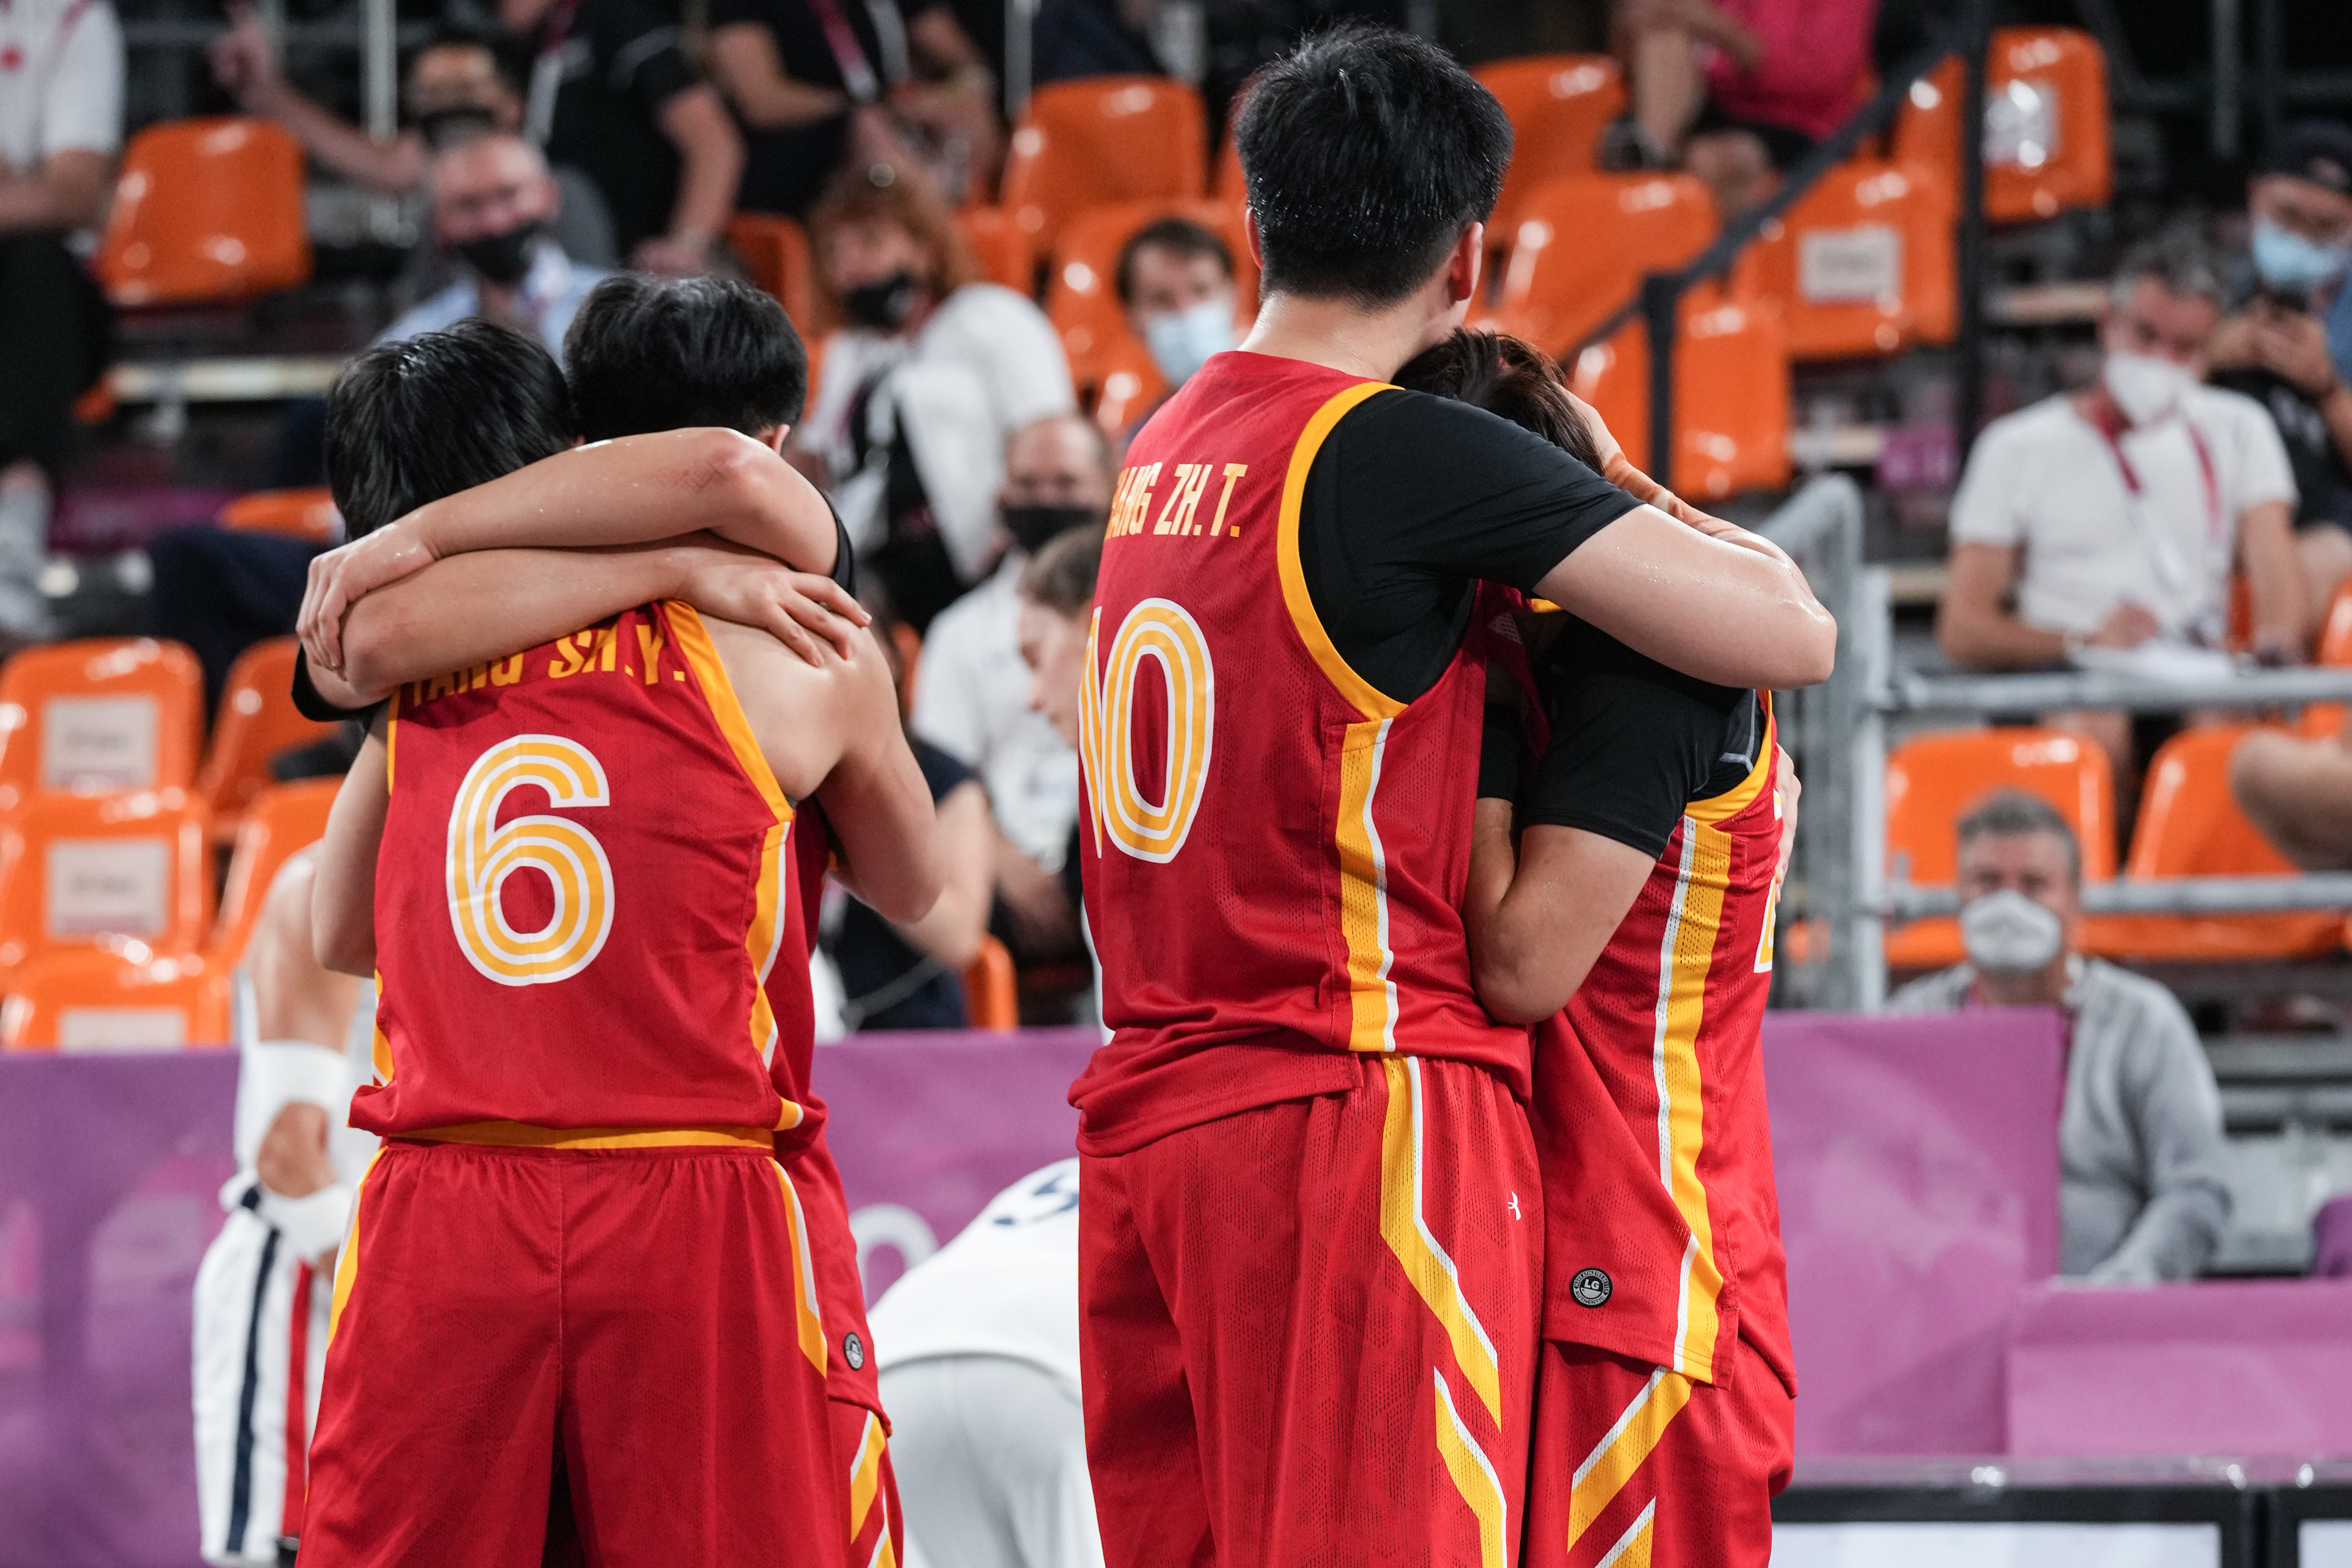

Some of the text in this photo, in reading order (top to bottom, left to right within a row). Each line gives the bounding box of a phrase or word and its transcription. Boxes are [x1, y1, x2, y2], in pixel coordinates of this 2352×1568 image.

[1153, 463, 1248, 538] ZH.T.
[446, 734, 615, 987] 6
[1575, 1290, 1605, 1305] AUTHENTIC
[1584, 1278, 1600, 1290] LG
